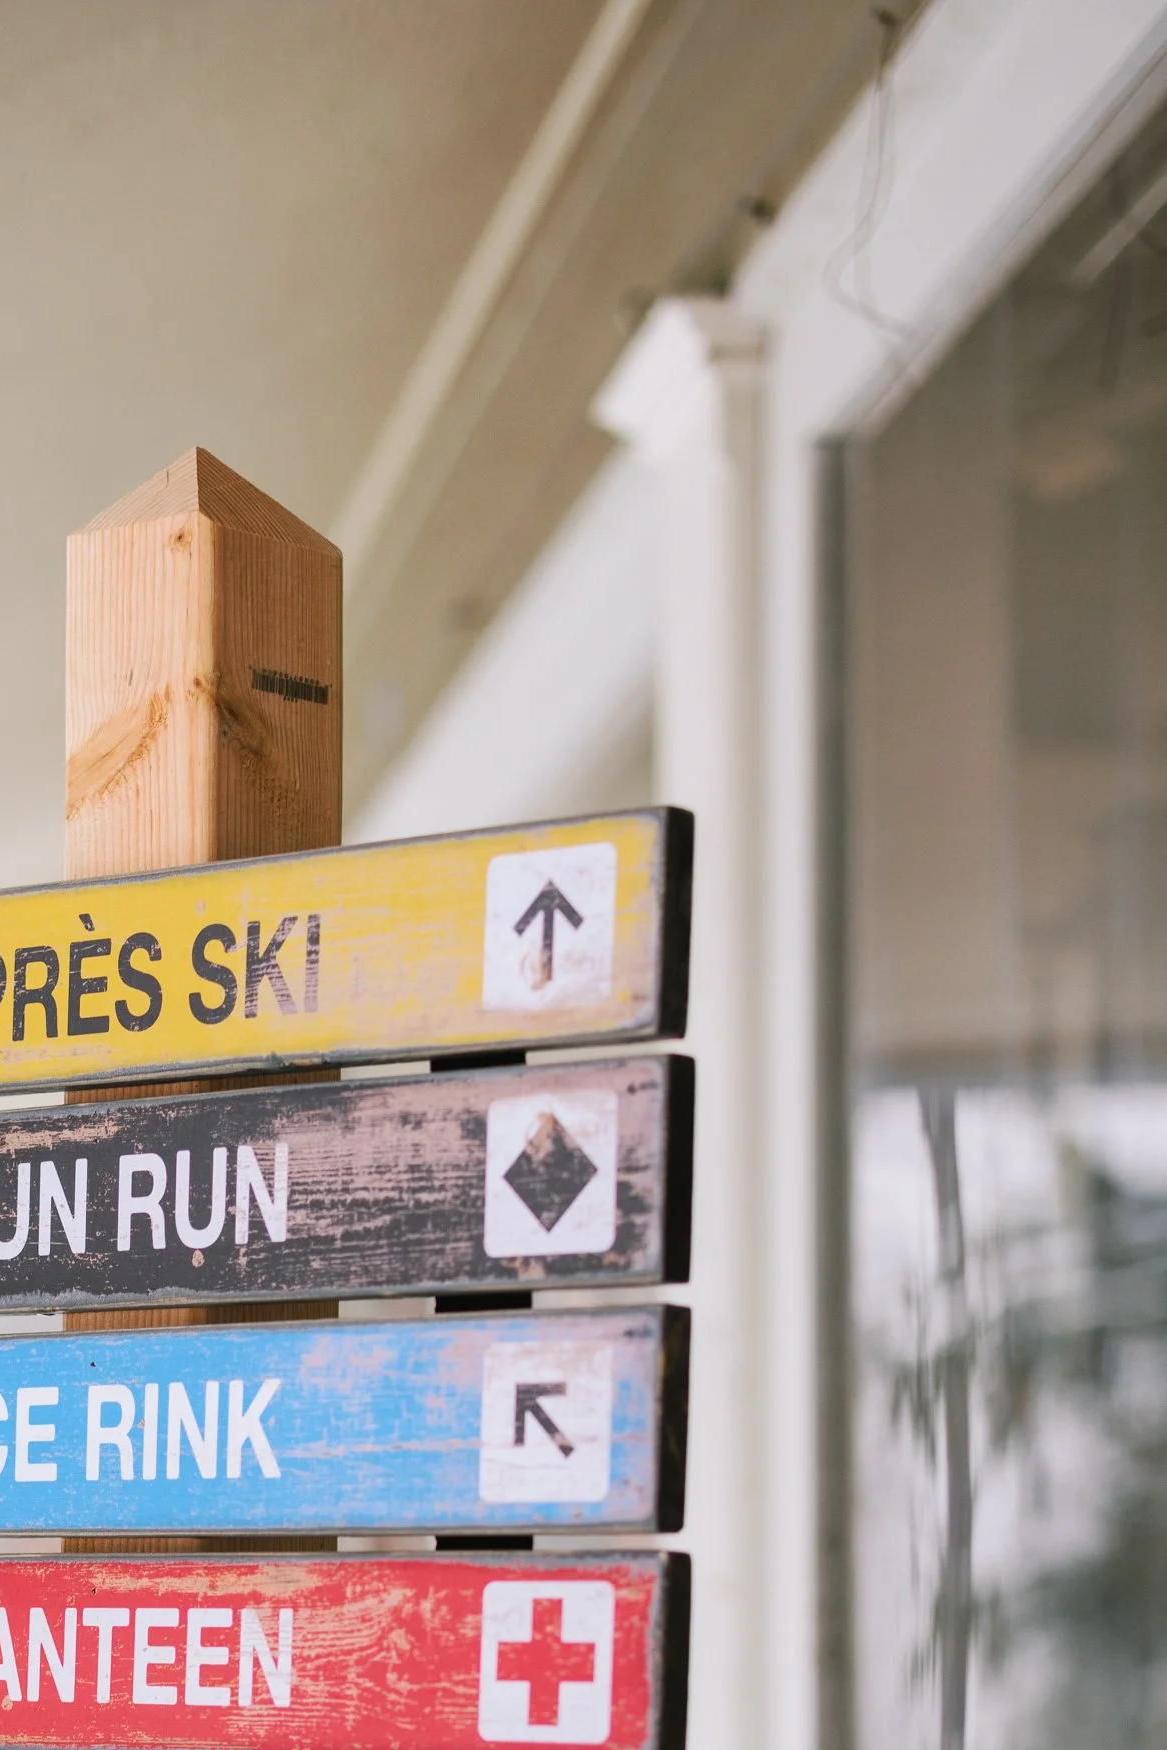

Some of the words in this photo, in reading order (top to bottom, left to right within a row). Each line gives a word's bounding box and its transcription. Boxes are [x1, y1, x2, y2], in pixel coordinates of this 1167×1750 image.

[188, 912, 322, 1025] SKI
[117, 1141, 289, 1251] RUN
[85, 1378, 282, 1481] RINK
